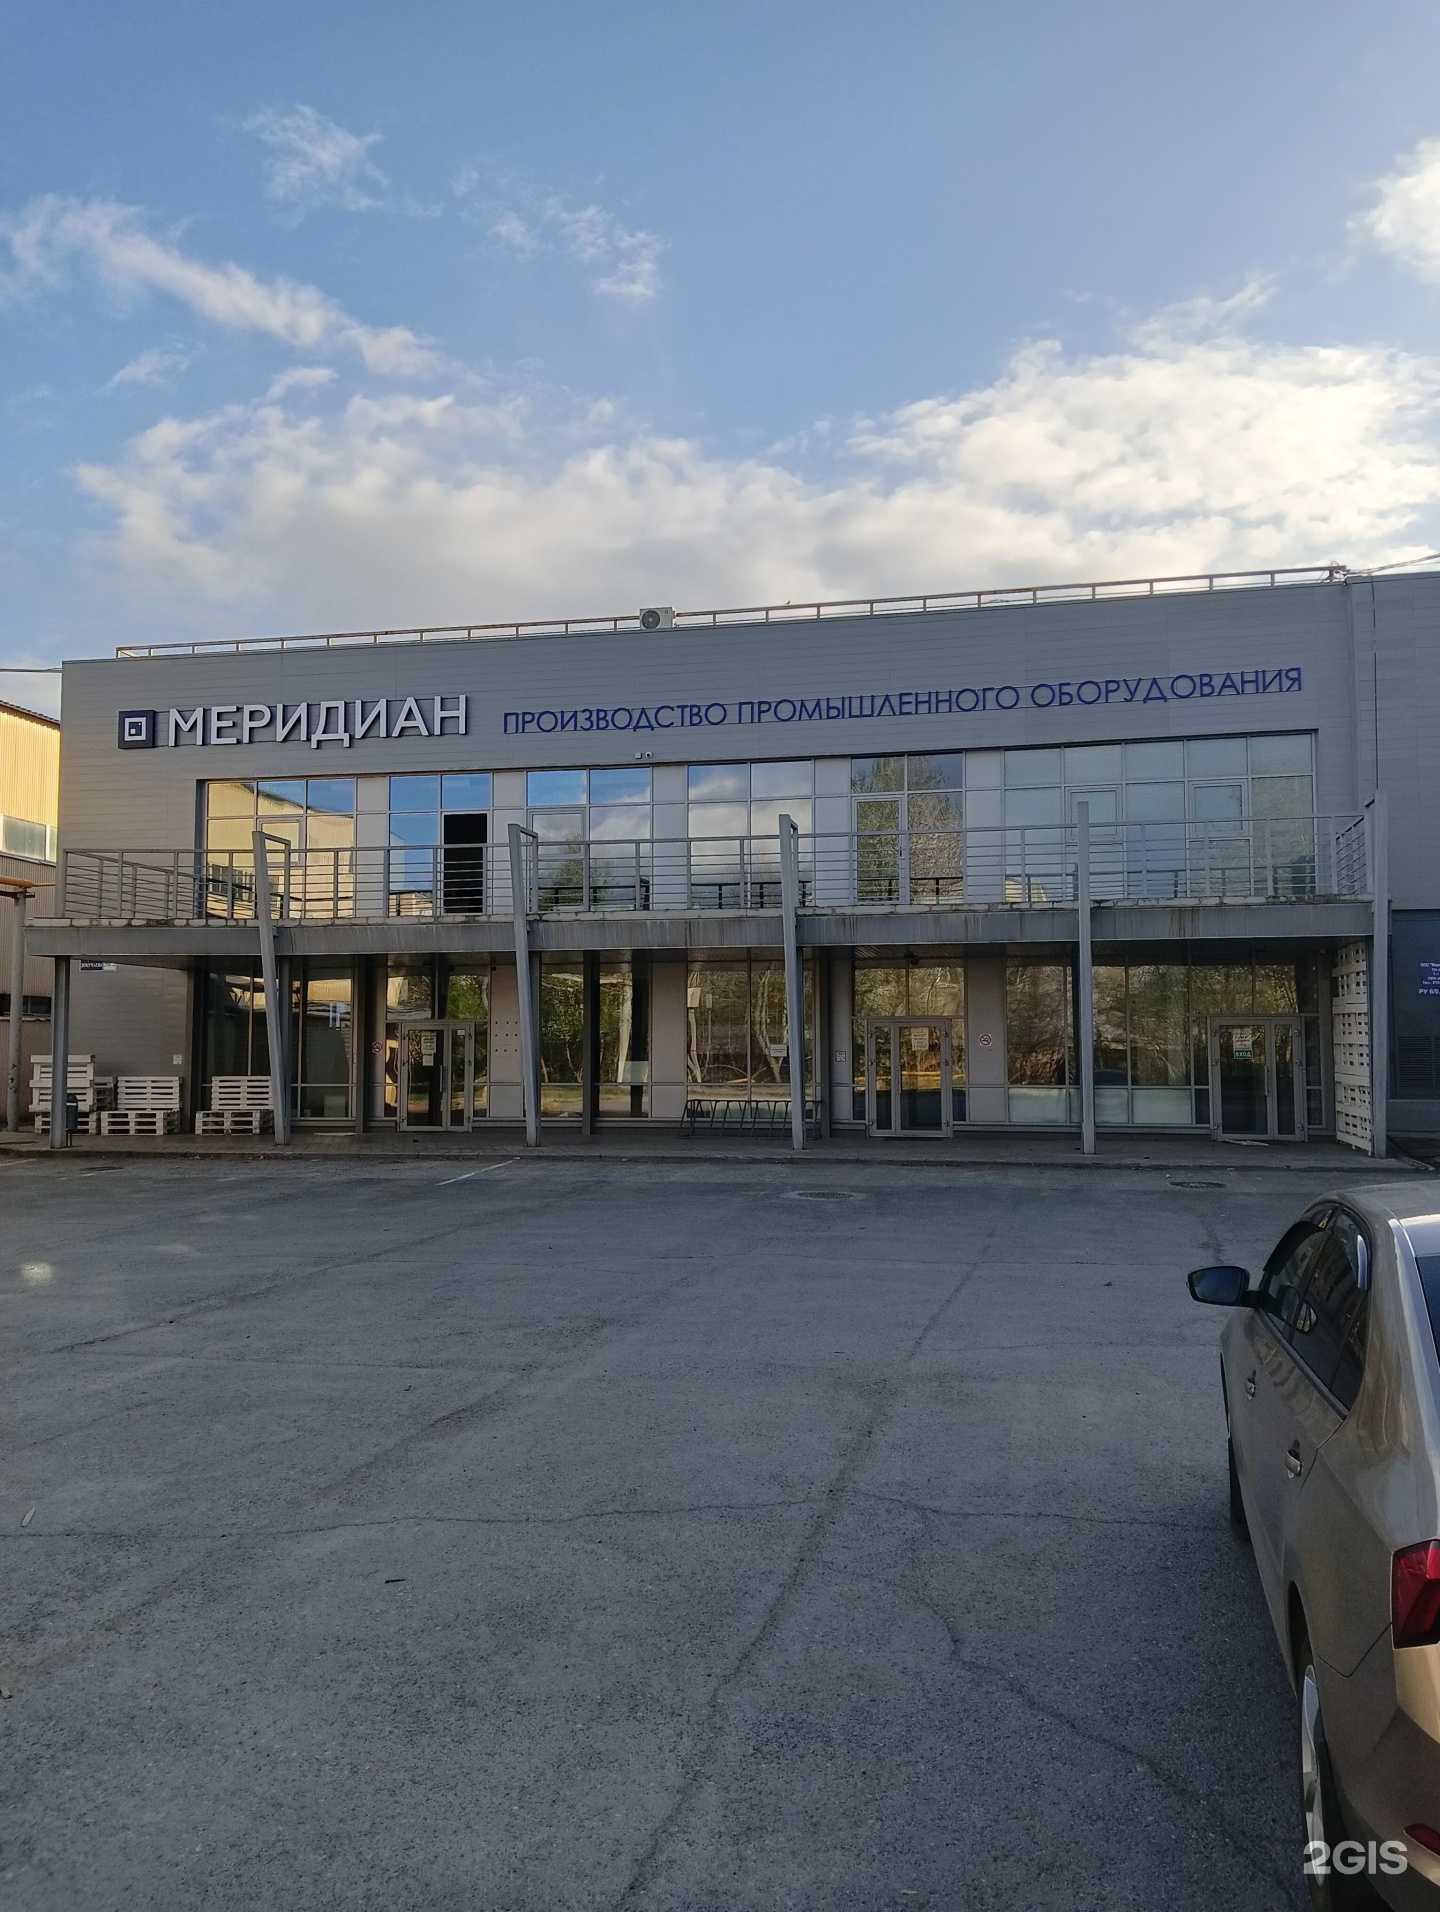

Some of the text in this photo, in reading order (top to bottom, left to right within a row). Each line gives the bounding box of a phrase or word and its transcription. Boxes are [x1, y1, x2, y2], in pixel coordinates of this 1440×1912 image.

[168, 694, 467, 749] МЕРИДИАН
[503, 667, 1303, 735] ПРОИЗВОДСТВО ПРОМЫШЛЕННОГО ОБОРУДОВАНИЯ
